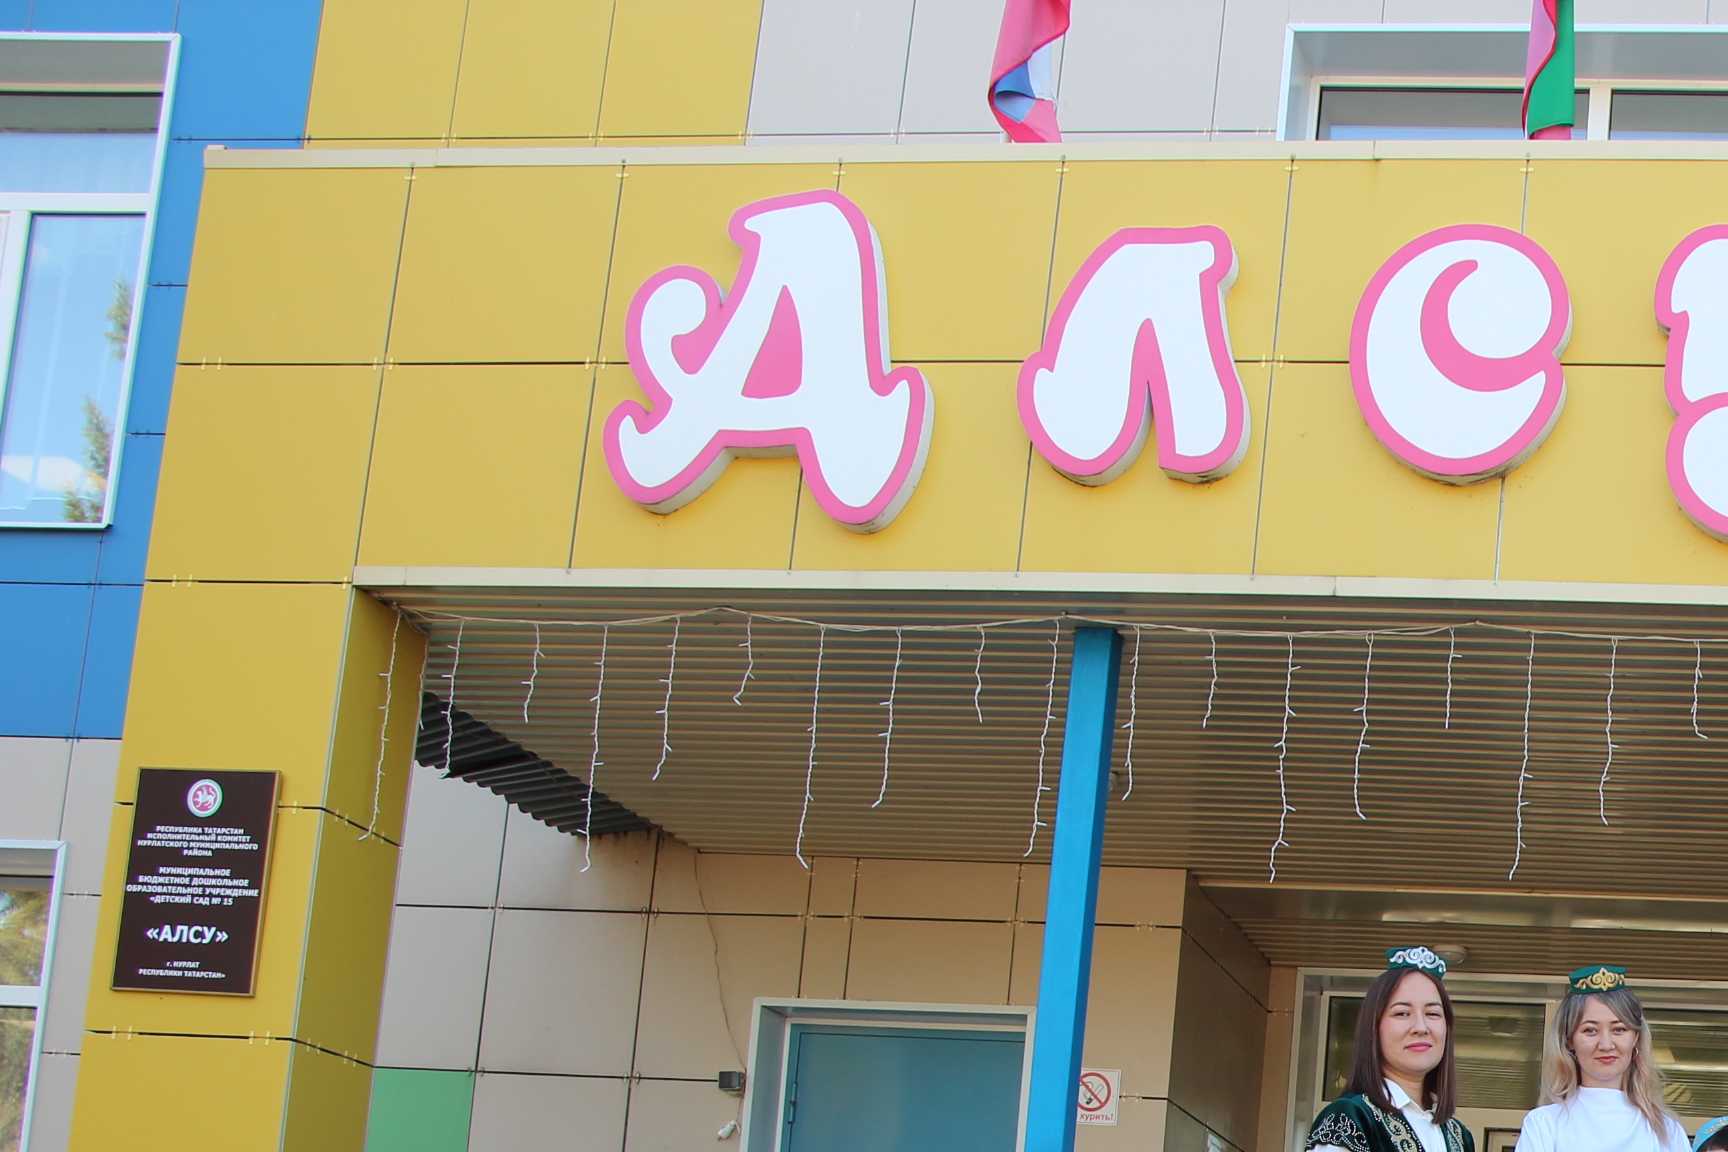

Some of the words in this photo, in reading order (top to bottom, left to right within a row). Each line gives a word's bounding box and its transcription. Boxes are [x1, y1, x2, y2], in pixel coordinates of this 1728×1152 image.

[156, 826, 202, 834] РЕСПУБЛИКА
[204, 827, 244, 835] ТАТАРСТАН
[147, 833, 216, 841] ИСПОЛНИТЕЛЬНЫЙ
[138, 840, 188, 848] НУРЛАТСКОГО
[190, 842, 259, 850] МУНИЦИПАЛЬНОГО
[184, 849, 213, 857] РАЙОНА
[159, 867, 231, 876] МУНИЦИПАЛЬНОЕ
[139, 875, 190, 885] БЮДЖЕТНОЕ
[192, 878, 249, 887] ДОШКОЛЬНОЕ
[127, 885, 203, 894] ОБРАЗОВАТЕЛЬНОЕ
[205, 888, 259, 897] УЧРЕЖДЕНИЕ
[150, 895, 192, 904] «ДЕТСКИЙ
[194, 897, 210, 905] САД
[147, 925, 229, 943] «АЛСУ»
[139, 969, 183, 977] РЕСПУБЛИКИ
[1080, 1113, 1114, 1121] курить!
